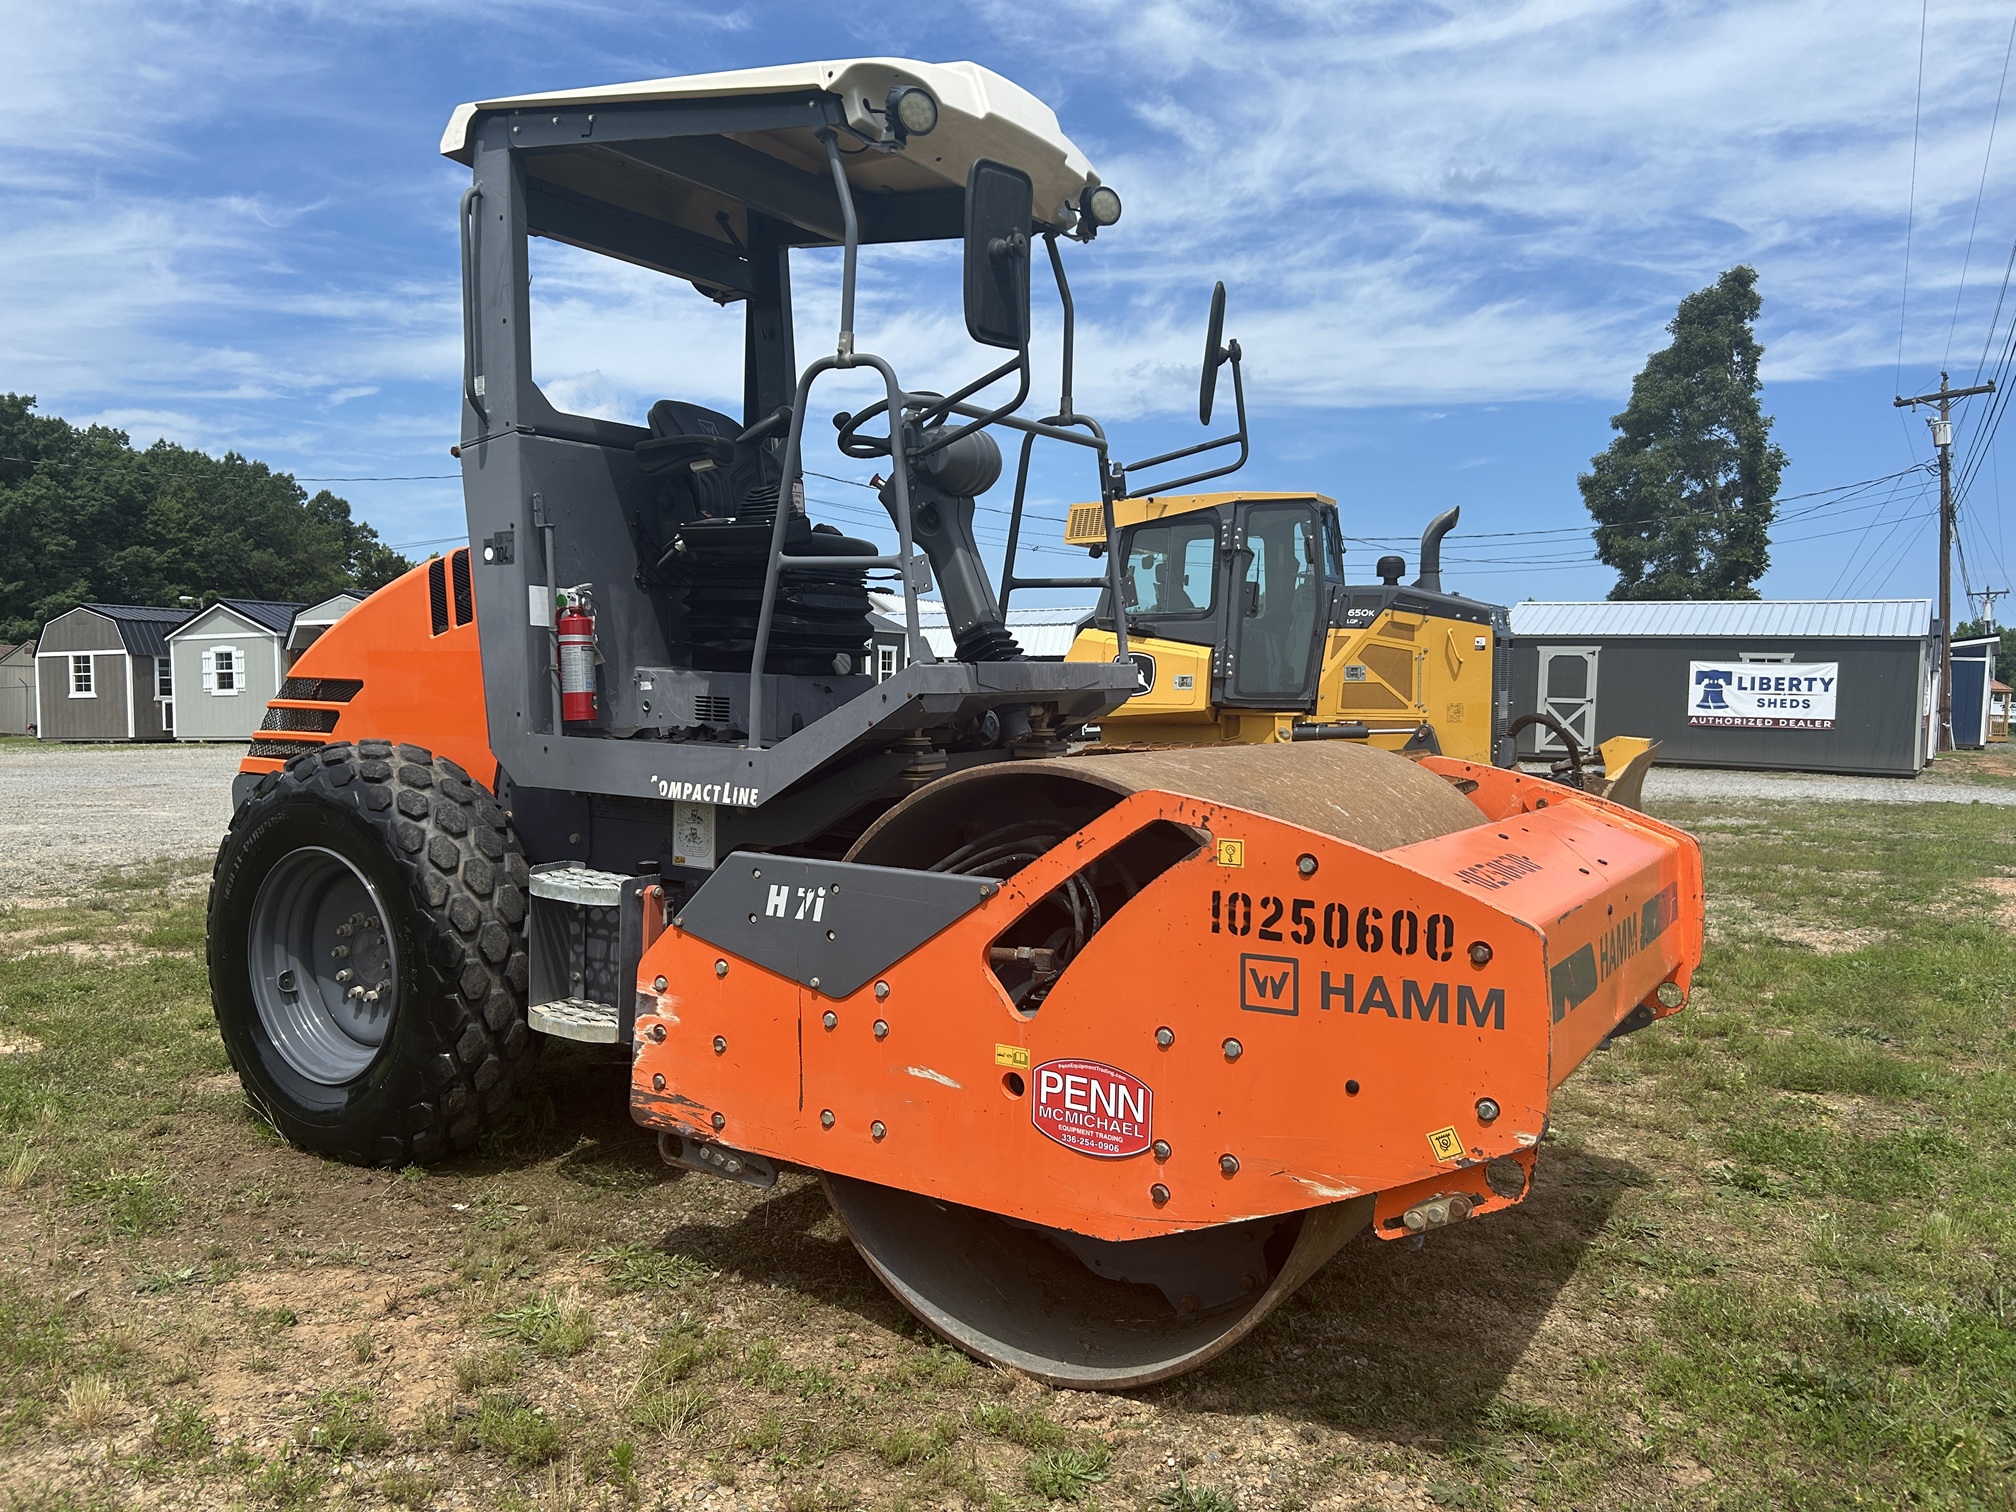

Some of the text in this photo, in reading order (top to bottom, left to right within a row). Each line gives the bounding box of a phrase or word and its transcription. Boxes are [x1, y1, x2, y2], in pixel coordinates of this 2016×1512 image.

[1347, 608, 1375, 617] 650K
[1737, 676, 1835, 692] LIBERTY
[1756, 697, 1811, 709] SHEDS
[1689, 716, 1832, 728] AUTHORIZED DEALER
[650, 774, 759, 806] OMPACTLINE
[765, 884, 790, 918] H
[1211, 890, 1455, 962] 10250600
[1599, 911, 1638, 983] HAMM
[1249, 967, 1506, 1030] W HAMM
[1058, 1062, 1127, 1081] PennEquipmentTrading.com
[1040, 1069, 1145, 1124] PENN
[1039, 1105, 1144, 1138] MCMICHAEL
[1058, 1124, 1124, 1143] EQUIPMENT TRADING
[1061, 1133, 1120, 1153] 336-254-0906
